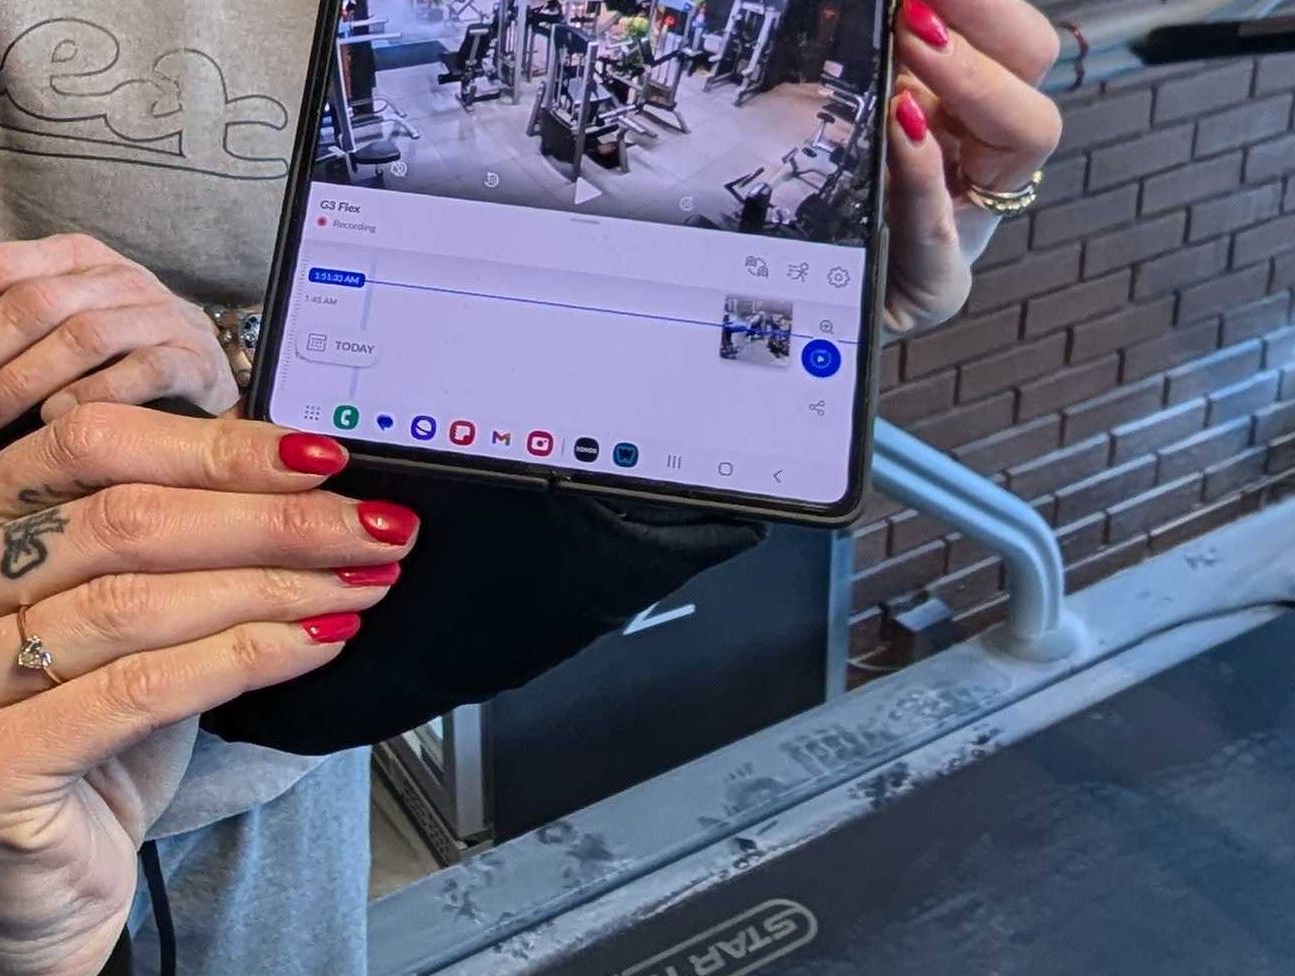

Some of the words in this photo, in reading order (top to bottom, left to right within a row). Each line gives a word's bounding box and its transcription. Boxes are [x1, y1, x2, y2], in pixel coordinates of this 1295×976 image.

[320, 199, 336, 210] G3
[338, 202, 361, 213] Flex
[333, 219, 376, 234] Recording
[344, 275, 361, 285] AM
[322, 297, 338, 305] AM
[335, 340, 375, 354] TODAY
[689, 908, 803, 976] STAR
